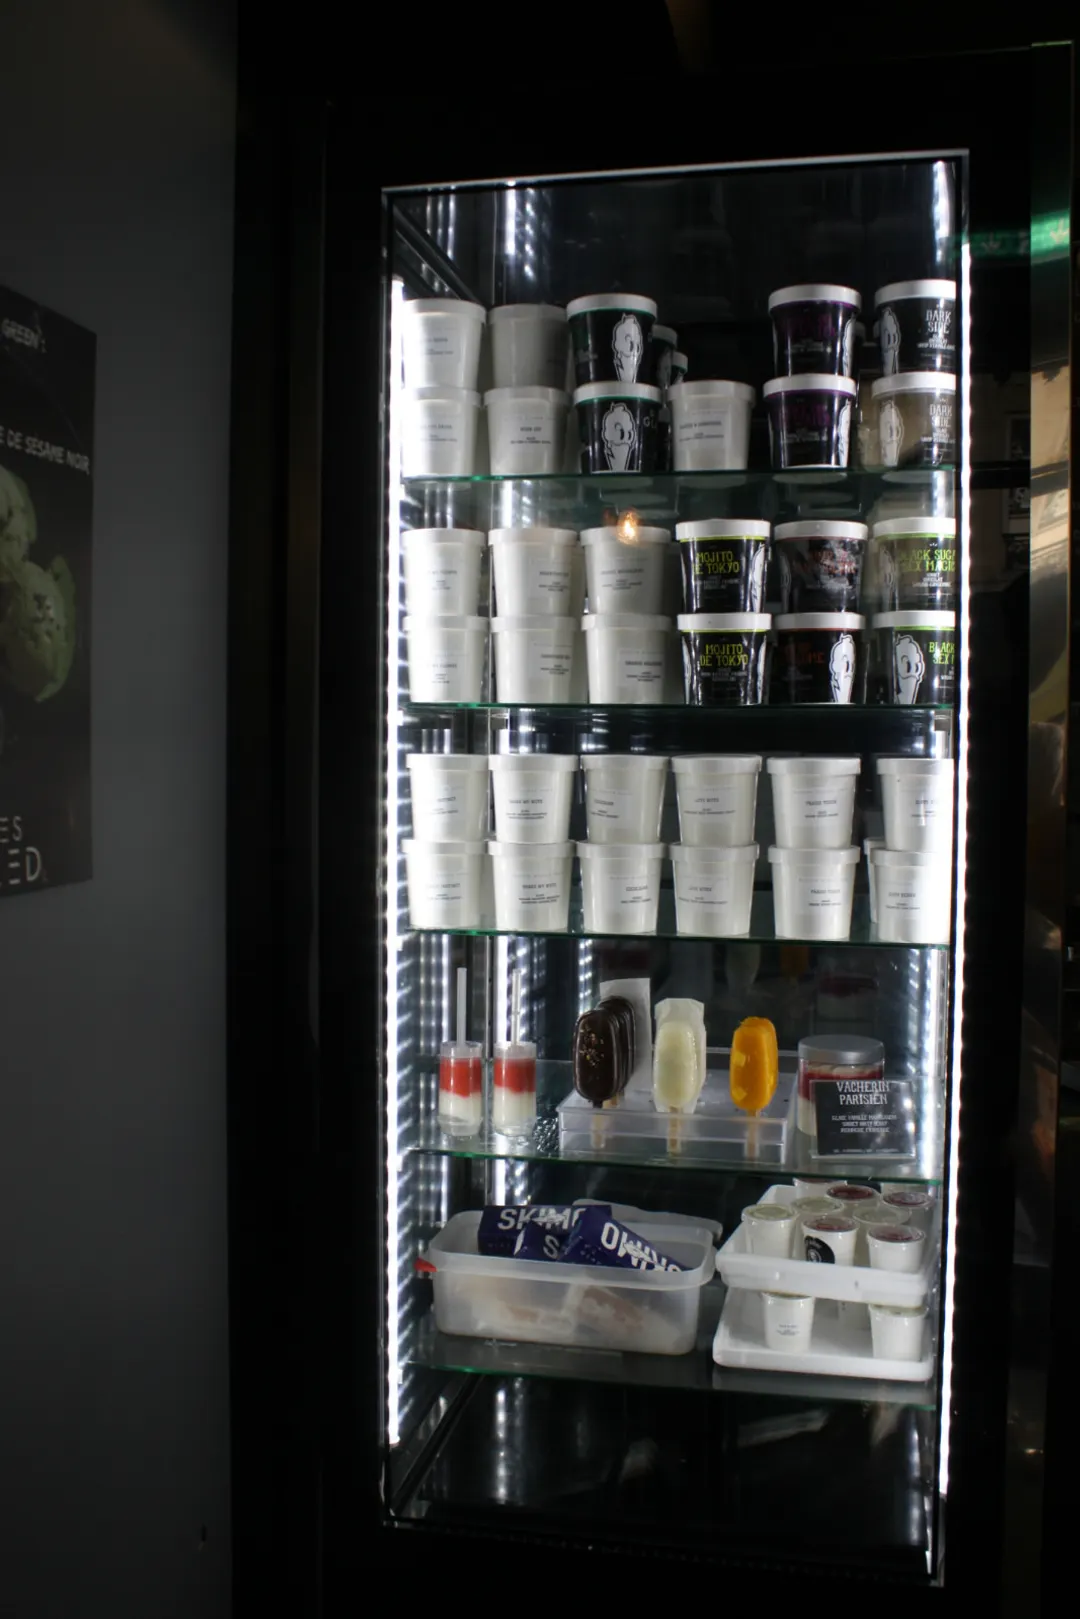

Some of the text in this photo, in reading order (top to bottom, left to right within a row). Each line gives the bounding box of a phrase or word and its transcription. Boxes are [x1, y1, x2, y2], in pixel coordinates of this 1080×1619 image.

[925, 309, 952, 323] DARK
[927, 321, 950, 334] SIDE
[929, 403, 953, 417] DARK
[6, 428, 23, 450] DE
[696, 550, 733, 563] MOJITO
[707, 561, 740, 575] TOKYO
[705, 643, 744, 656] MOJITO
[700, 654, 749, 668] DE TOKYO
[836, 1080, 890, 1093] VACHERIN
[839, 1093, 888, 1106] PARISIEN
